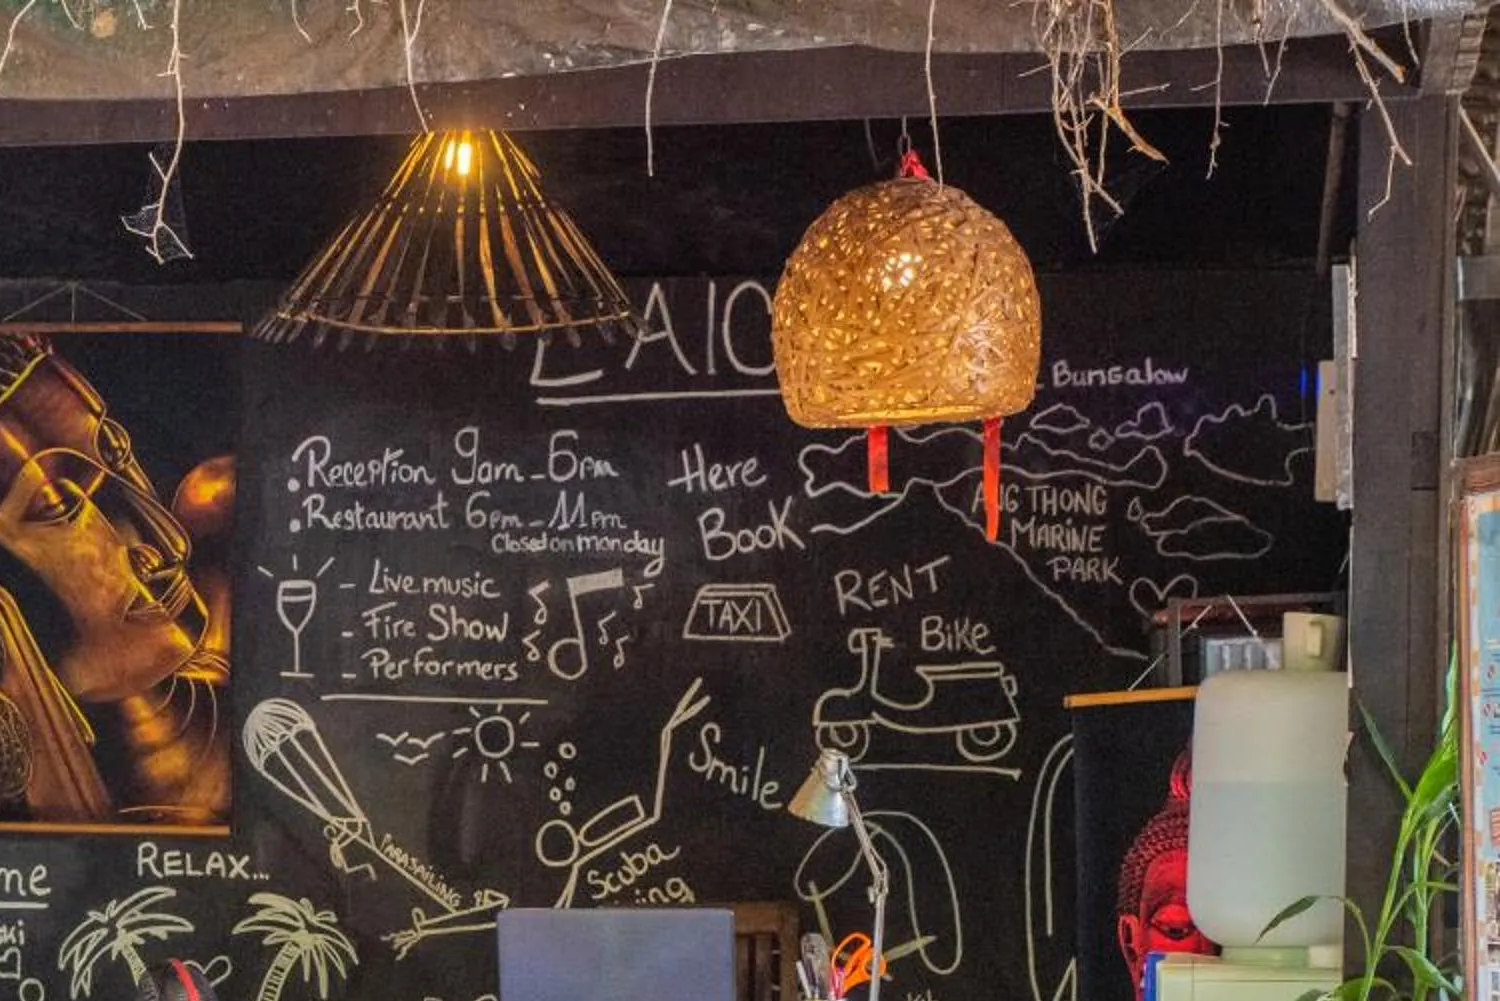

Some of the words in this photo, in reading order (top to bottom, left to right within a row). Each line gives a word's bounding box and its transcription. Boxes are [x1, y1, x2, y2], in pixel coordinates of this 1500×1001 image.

[291, 435, 436, 487] Reception
[668, 444, 767, 492] Here
[302, 491, 450, 530] Restaurant
[972, 480, 1019, 513] AG
[1024, 483, 1107, 516] THONG
[491, 531, 548, 553] Closed
[551, 538, 573, 552] on
[576, 530, 664, 577] monday
[1046, 556, 1123, 585] PARK
[368, 559, 421, 596] Live
[423, 570, 499, 597] music
[835, 556, 950, 614] RENT
[362, 602, 415, 638] Fire
[428, 603, 508, 641] Show
[700, 600, 762, 632] TAXI
[361, 648, 518, 681] Performers
[688, 723, 782, 810] Smile
[588, 844, 681, 899] Scuba
